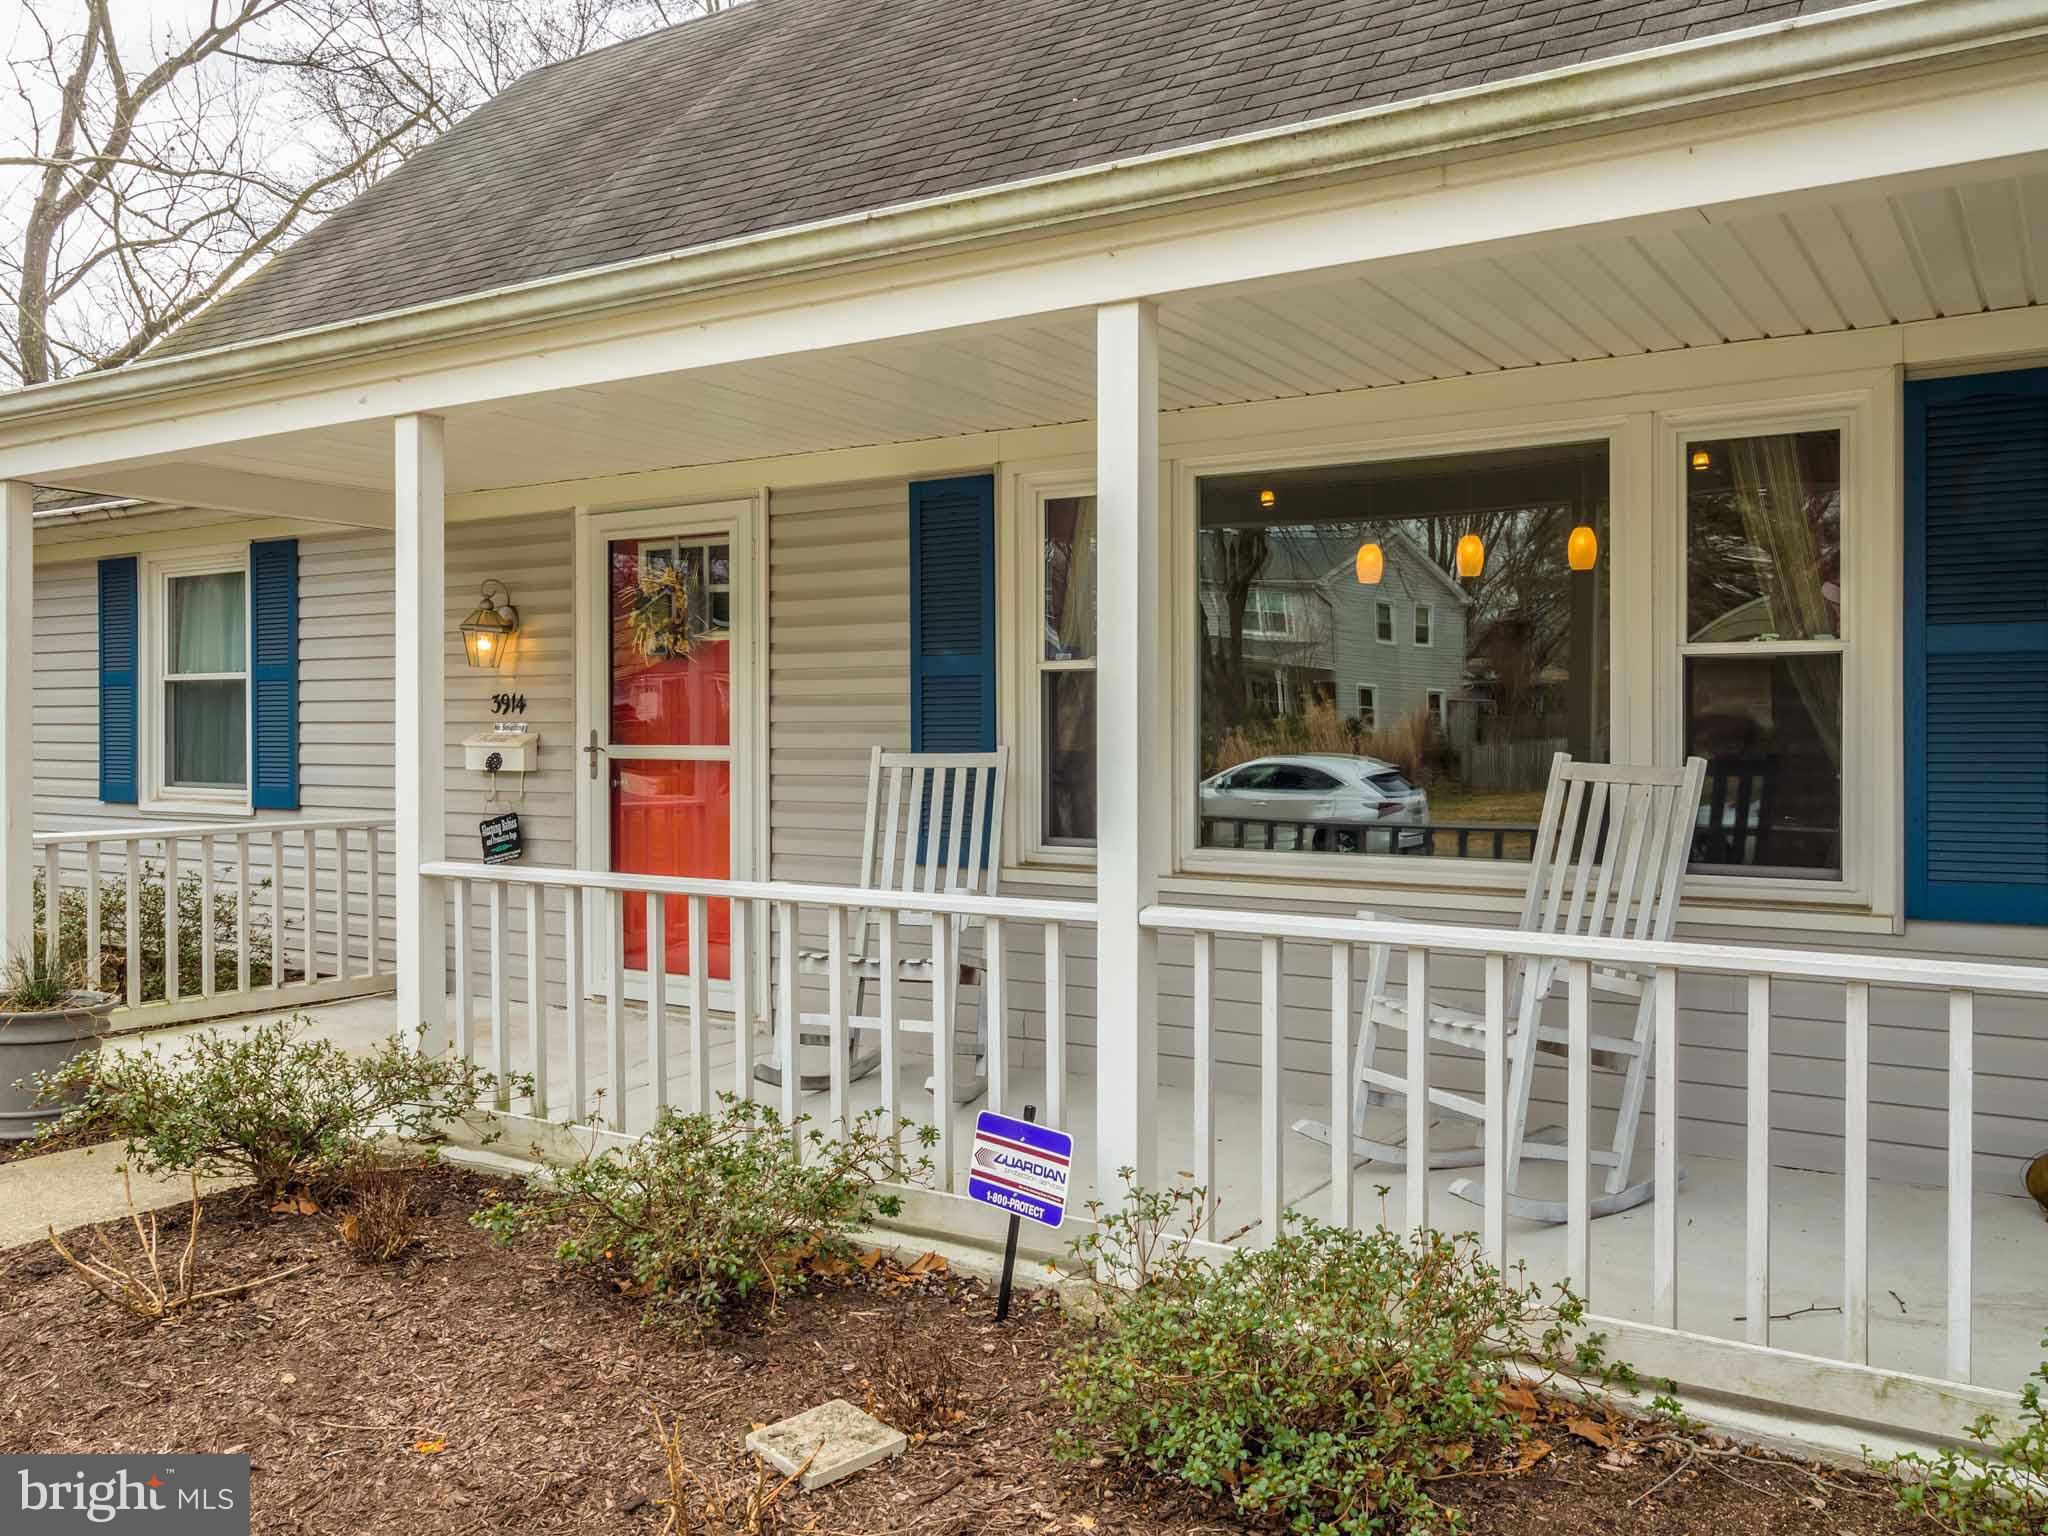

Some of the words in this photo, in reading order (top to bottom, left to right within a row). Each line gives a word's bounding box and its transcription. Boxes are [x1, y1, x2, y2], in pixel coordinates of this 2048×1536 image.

[490, 692, 527, 715] 3914
[993, 1153, 1067, 1185] GUARDIAN
[986, 1190, 1046, 1219] 1-800-PROTECT
